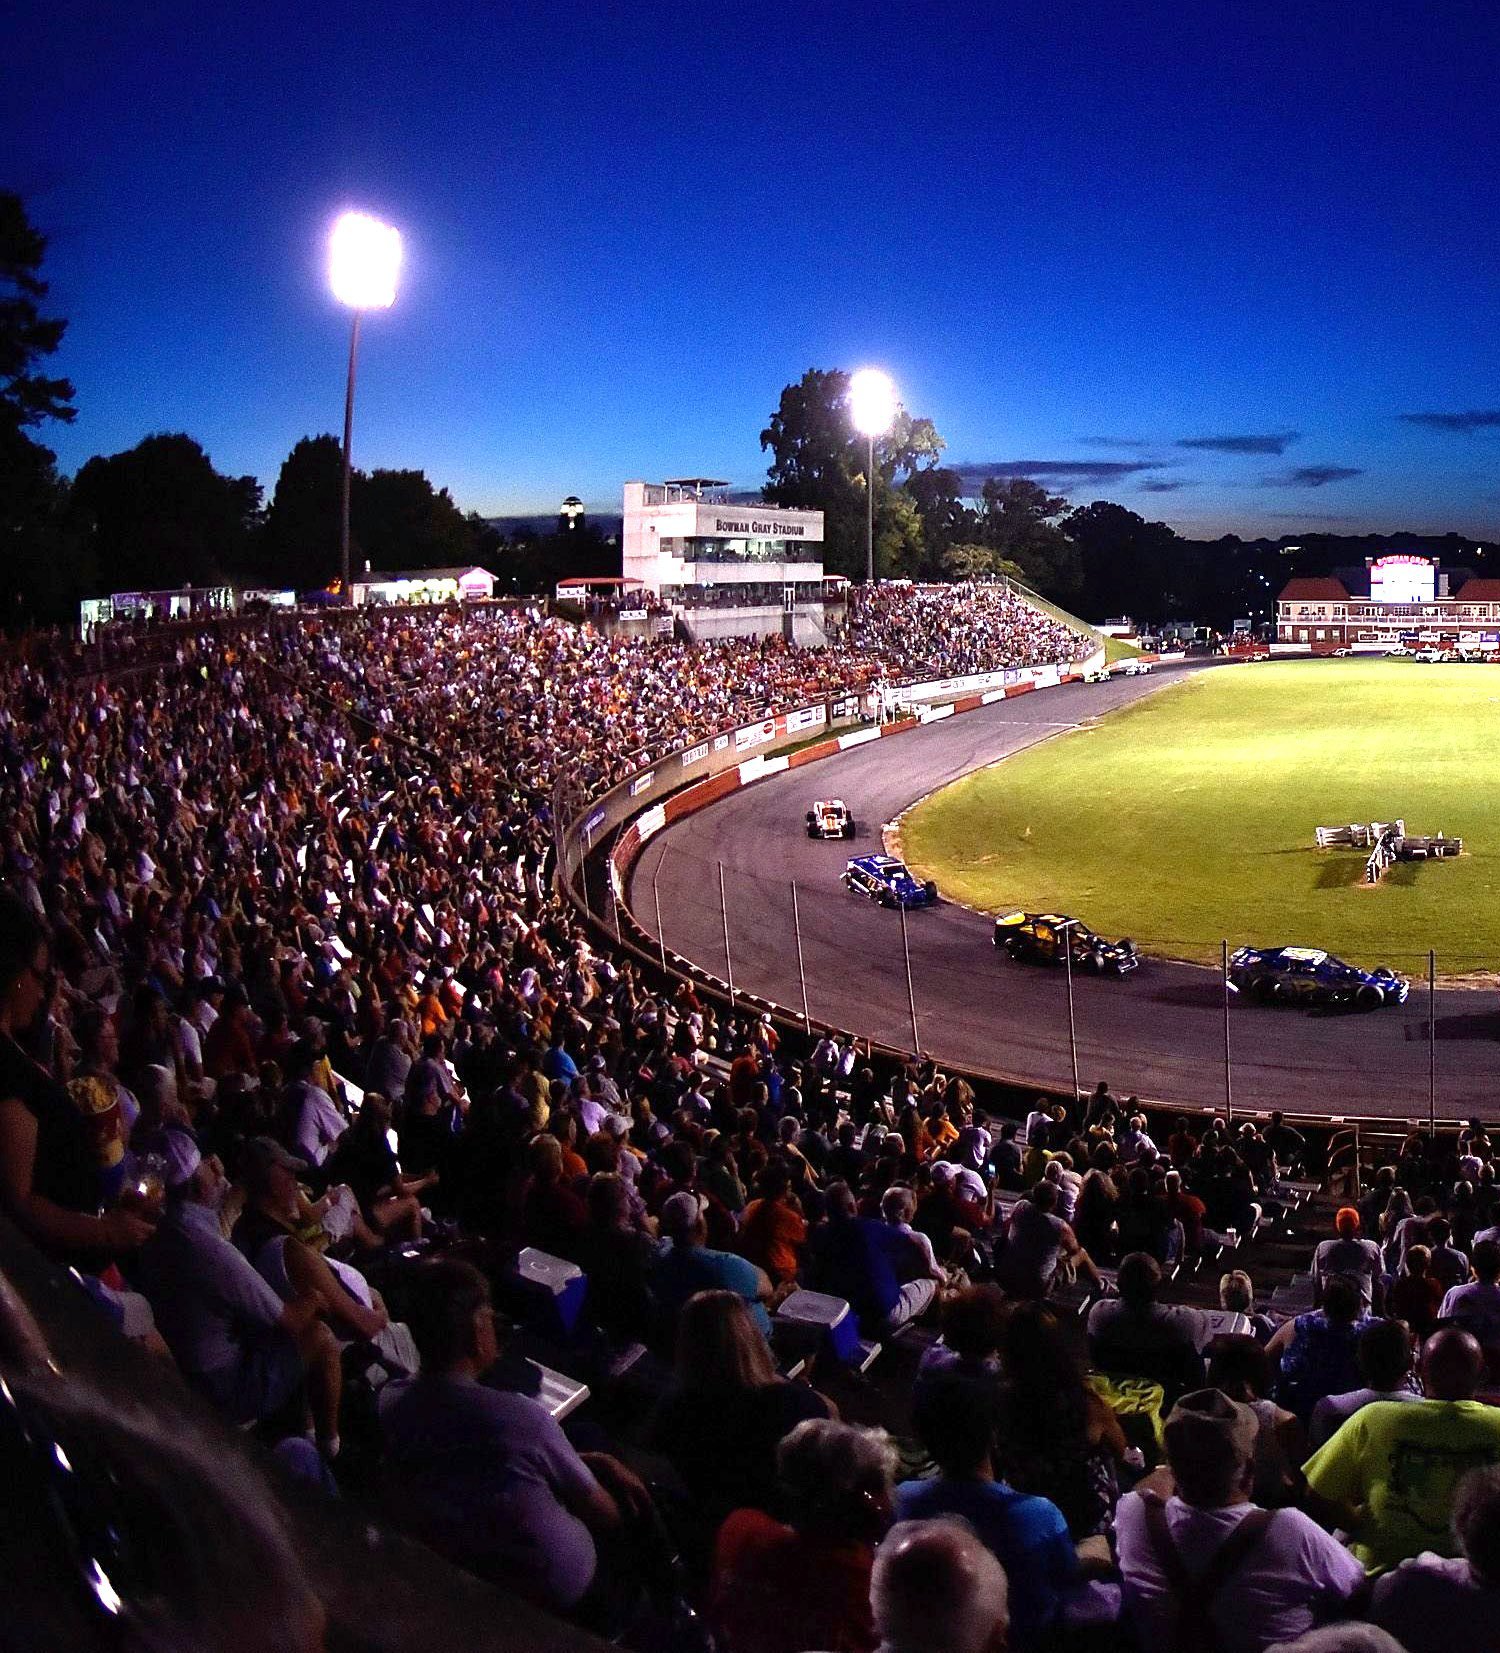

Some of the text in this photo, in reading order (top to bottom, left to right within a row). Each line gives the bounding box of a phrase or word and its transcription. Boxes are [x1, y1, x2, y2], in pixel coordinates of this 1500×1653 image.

[716, 519, 804, 535] BOWMAN GRAY STADIUM
